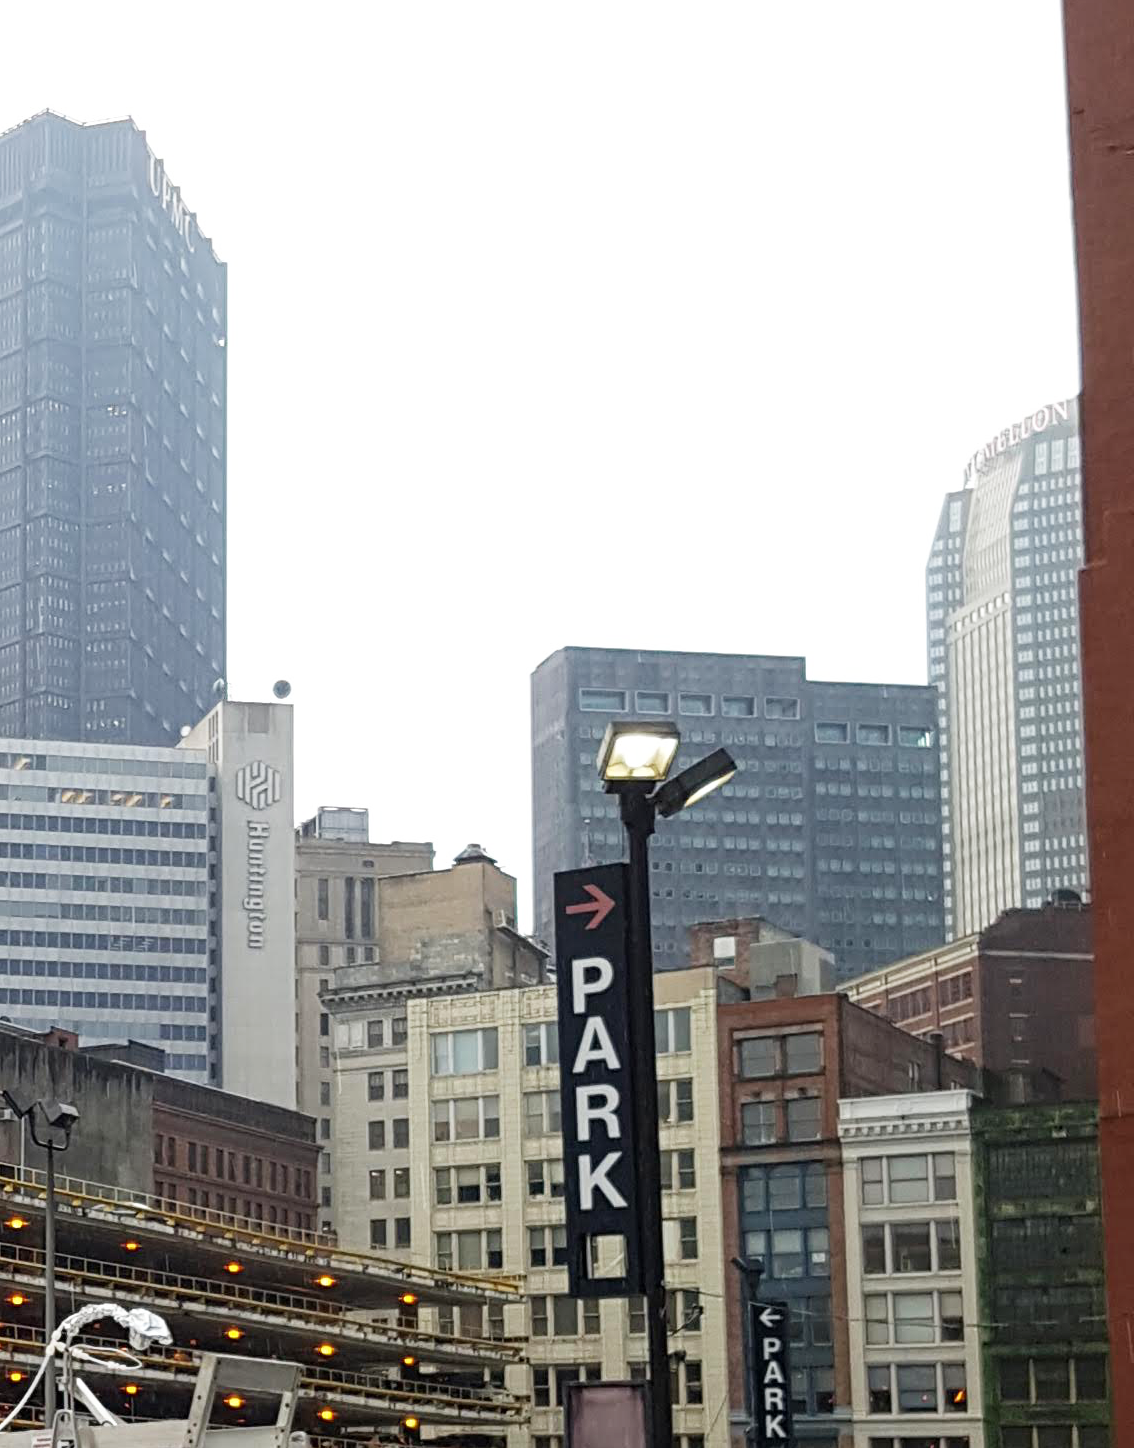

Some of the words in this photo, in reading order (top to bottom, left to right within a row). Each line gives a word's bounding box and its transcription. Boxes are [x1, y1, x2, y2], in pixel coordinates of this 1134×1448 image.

[149, 153, 196, 254] UPMC
[242, 820, 269, 949] Huntington
[571, 957, 629, 1211] PARK
[763, 1337, 787, 1438] PARK
